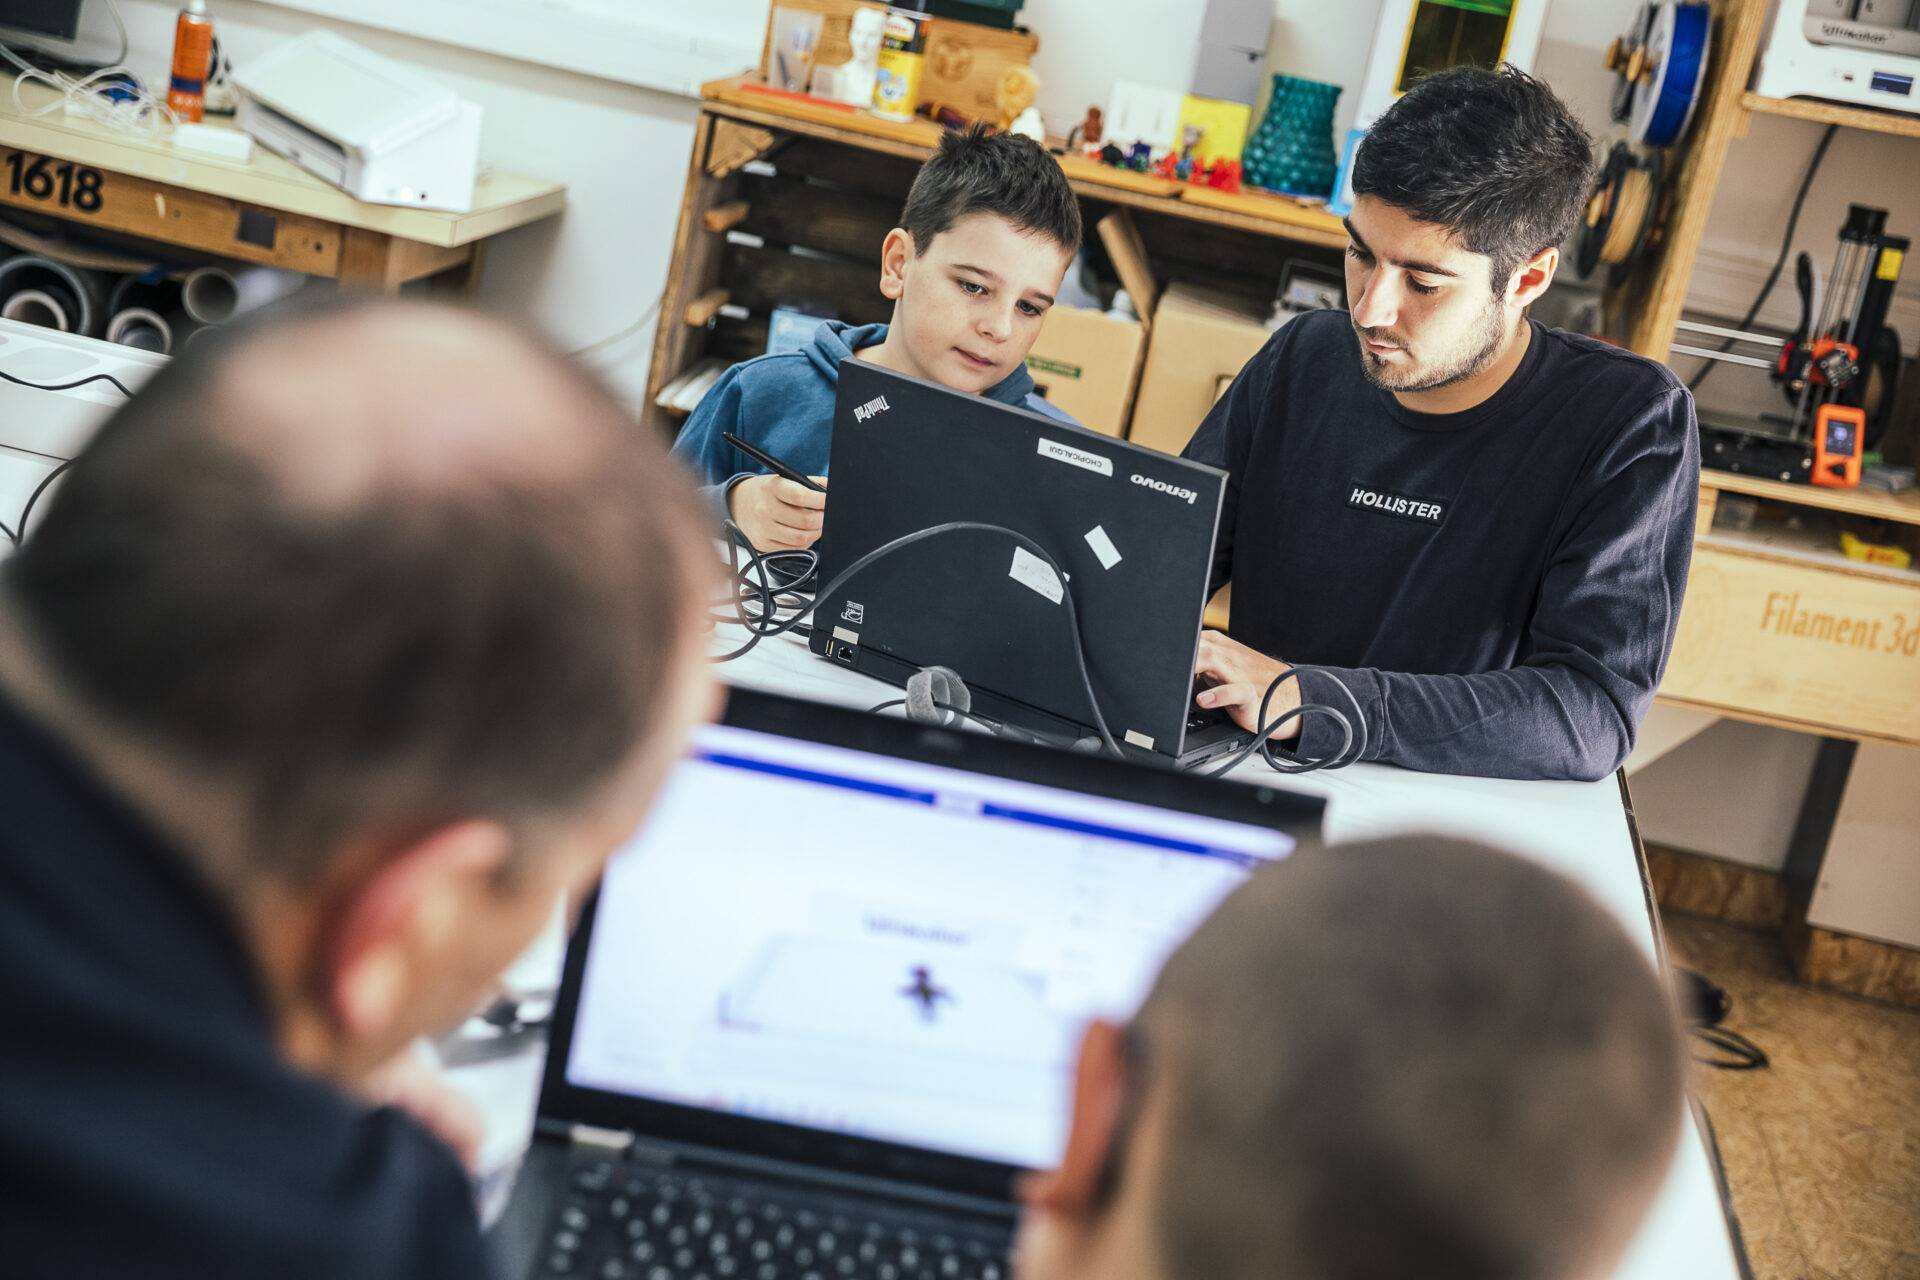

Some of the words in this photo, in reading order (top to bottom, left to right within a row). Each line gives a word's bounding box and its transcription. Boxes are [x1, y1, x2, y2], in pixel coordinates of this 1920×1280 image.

[6, 153, 103, 213] 1618
[853, 394, 890, 423] ThinkPad
[1130, 474, 1198, 505] lenovo
[1350, 488, 1442, 520] HOLLISTER
[1760, 591, 1882, 653] Filament
